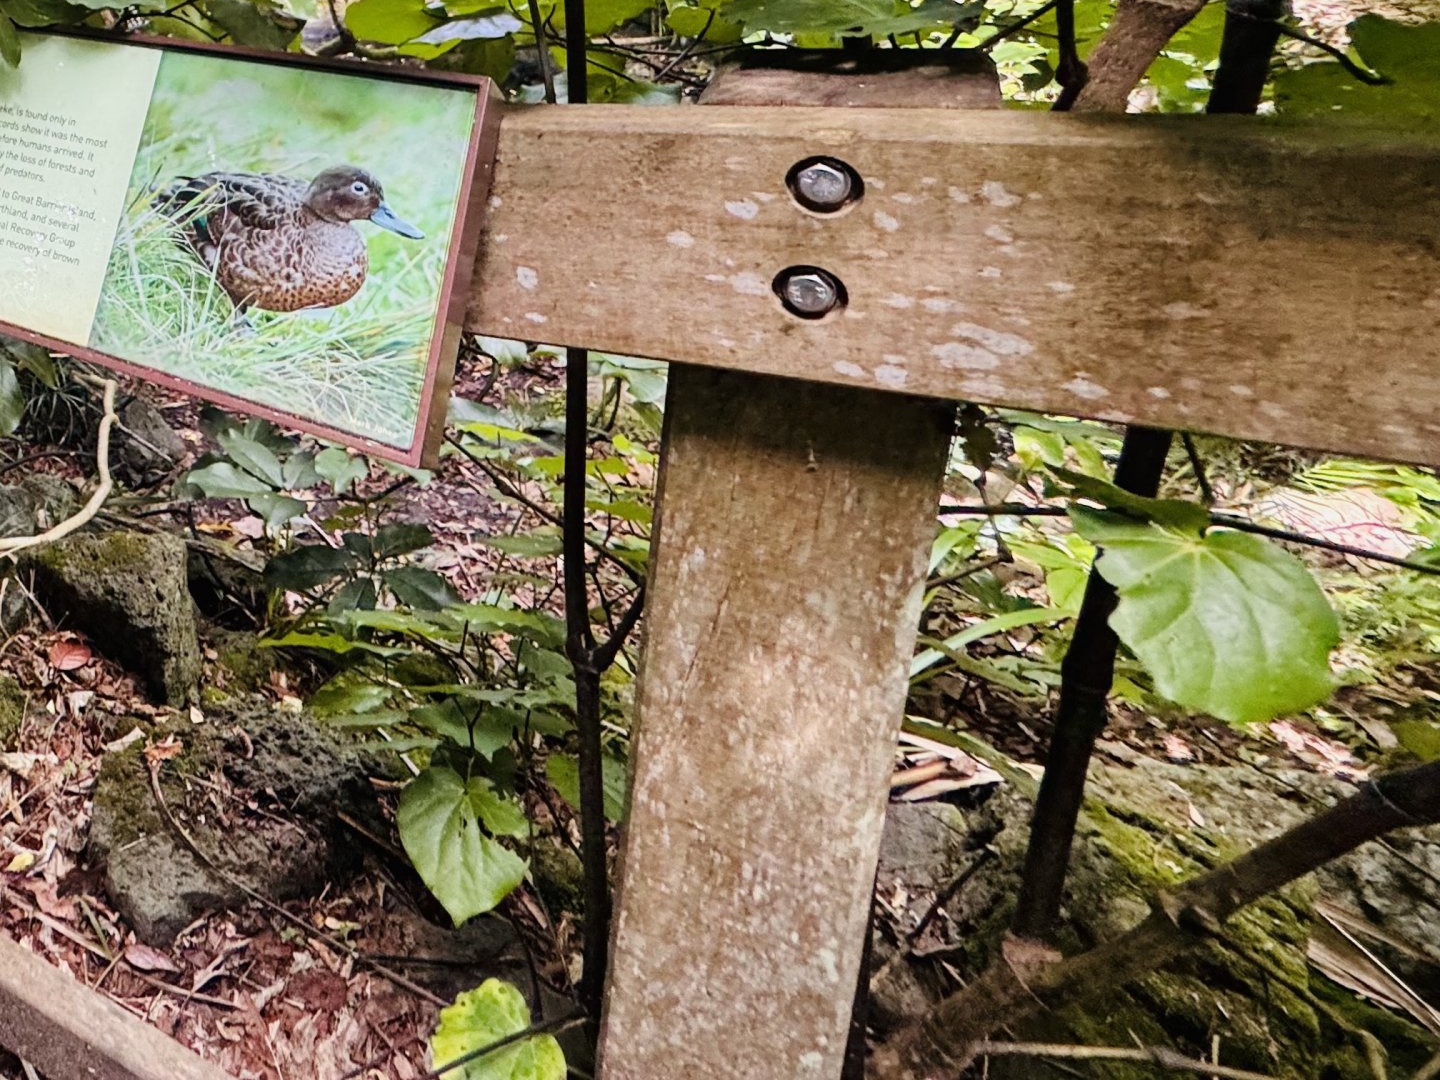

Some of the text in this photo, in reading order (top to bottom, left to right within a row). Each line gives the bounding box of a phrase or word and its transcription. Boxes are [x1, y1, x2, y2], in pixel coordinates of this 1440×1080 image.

[16, 107, 23, 116] is
[25, 108, 48, 120] found
[49, 114, 66, 126] only
[68, 116, 76, 126] in
[21, 123, 42, 135] show
[44, 127, 50, 136] it
[51, 130, 68, 140] was
[70, 132, 83, 143] the
[86, 137, 108, 147] most
[19, 138, 52, 153] humans
[54, 147, 84, 160] arrived.
[88, 151, 94, 161] It
[5, 167, 44, 182] predators.
[6, 150, 18, 161] the
[20, 153, 36, 165] loss
[38, 158, 46, 167] of
[48, 159, 76, 174] forests
[79, 168, 95, 178] and
[2, 188, 9, 198] to
[11, 190, 34, 204] Great
[31, 214, 47, 224] and
[48, 218, 79, 232] several
[6, 239, 40, 257] recovery
[53, 249, 79, 265] brown
